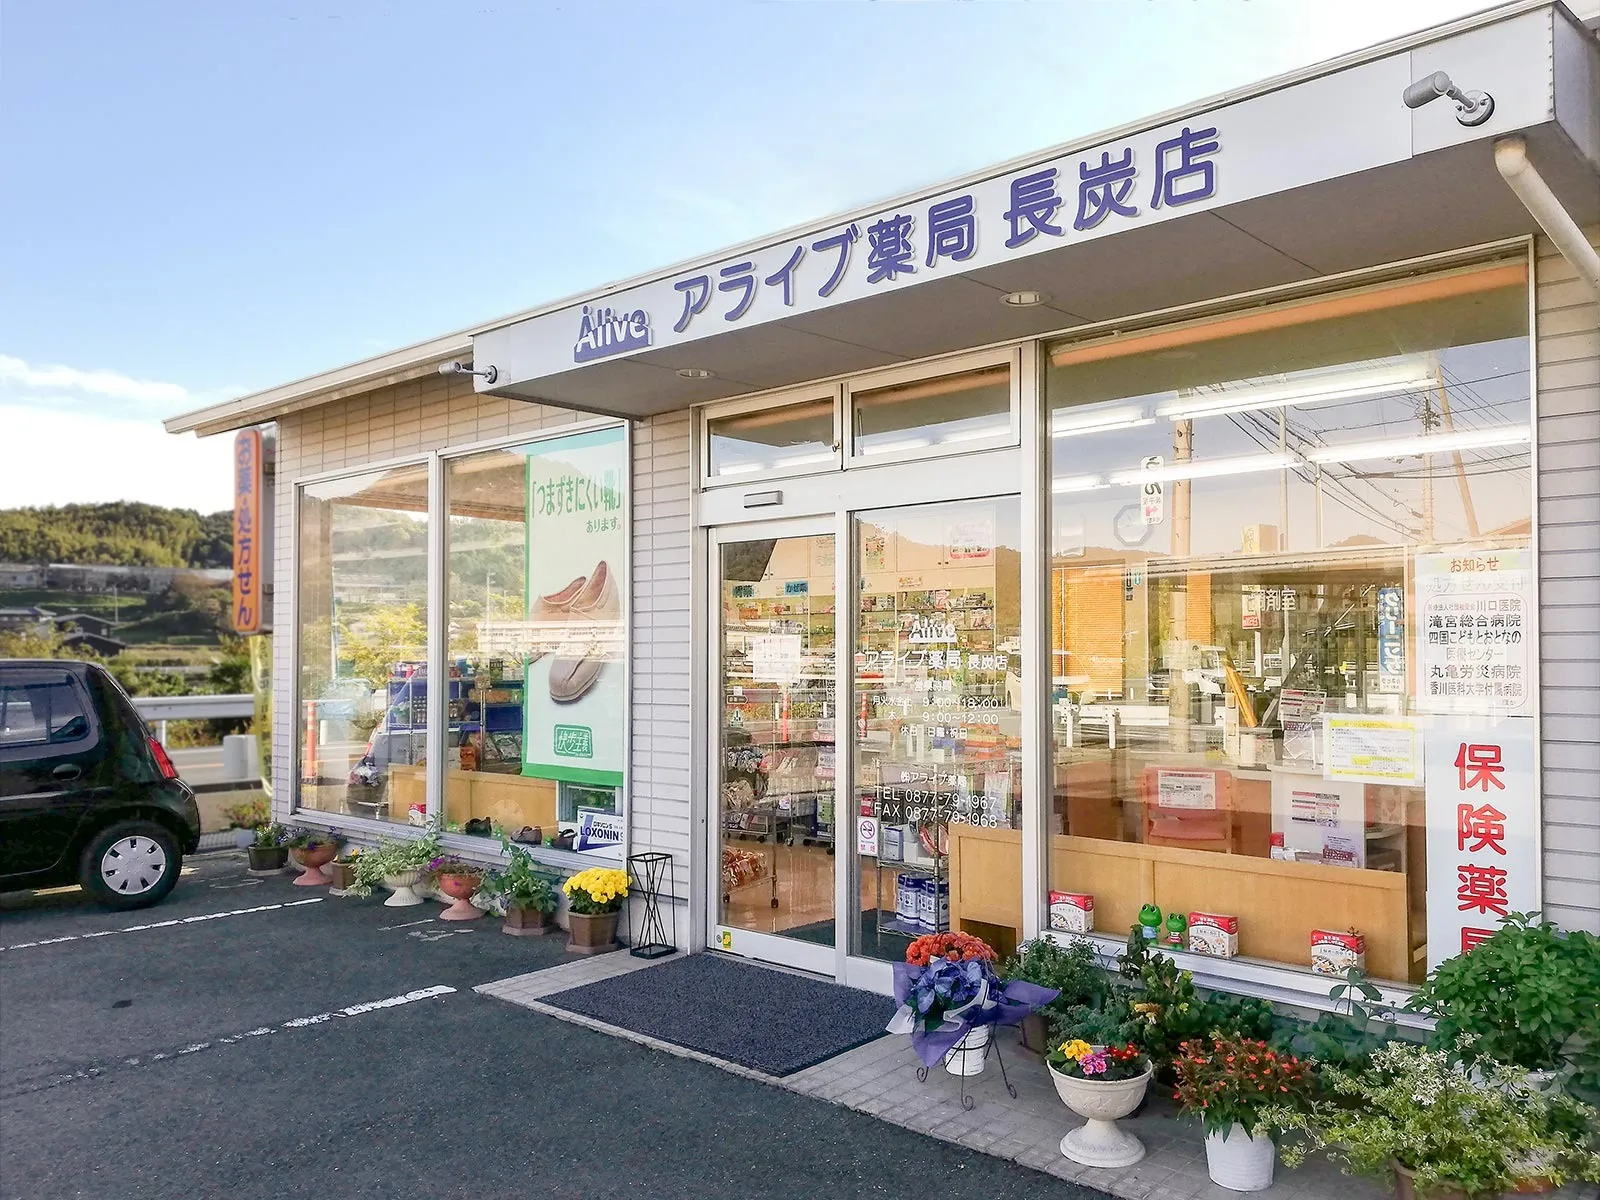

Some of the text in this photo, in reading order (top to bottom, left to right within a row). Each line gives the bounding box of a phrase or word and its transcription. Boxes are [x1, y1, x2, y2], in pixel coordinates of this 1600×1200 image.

[673, 127, 1219, 332] アライブ薬局 長炭店
[586, 516, 621, 533] あります。
[1450, 556, 1499, 573] お知らせ
[1476, 599, 1521, 612] 川口医院
[1428, 613, 1521, 628] 滝宮総合病院
[1428, 630, 1522, 645] 四国こどもとおとなの
[864, 650, 1009, 670] アライブ薬局 長炭店
[1446, 647, 1504, 661] 医療センター
[1430, 664, 1521, 679] 丸亀労災病院
[874, 785, 997, 811] TEL 0877-79-1967
[873, 802, 998, 829] FAX 0877-79-1968
[580, 825, 619, 841] LOXONIN
